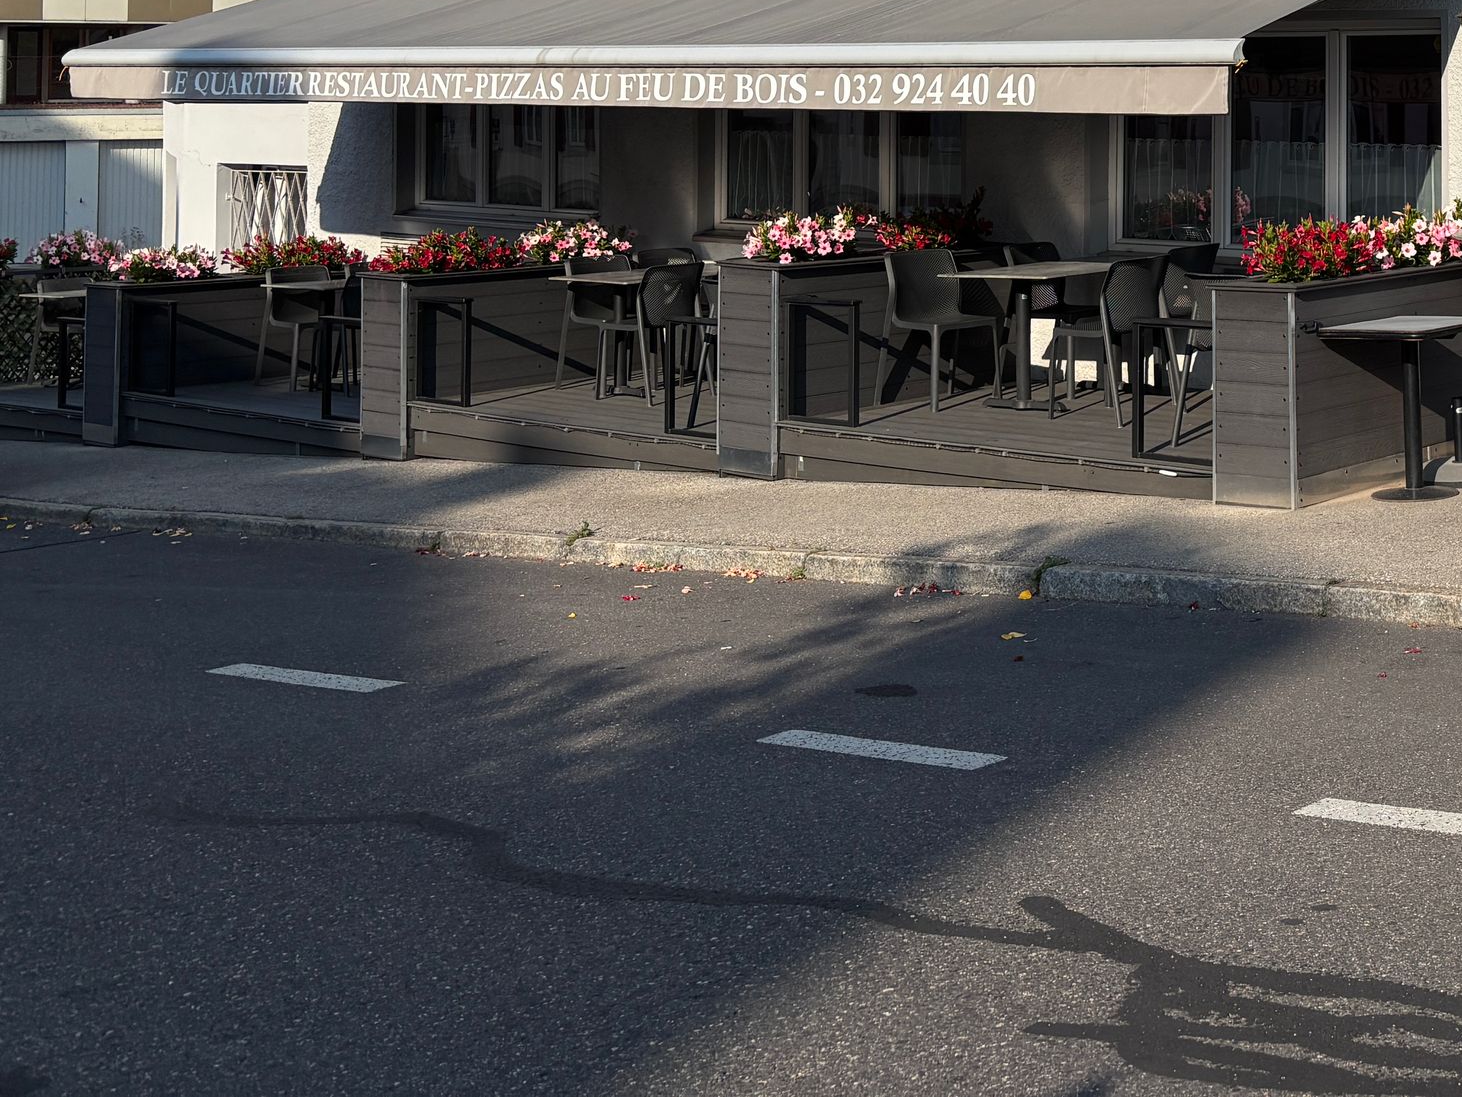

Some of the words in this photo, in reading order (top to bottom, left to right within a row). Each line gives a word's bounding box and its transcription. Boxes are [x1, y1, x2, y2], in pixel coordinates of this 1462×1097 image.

[161, 70, 189, 95] LE
[194, 70, 304, 96] QUARTIER
[571, 73, 612, 101] AU
[616, 72, 676, 102] FEU
[681, 73, 727, 102] DE
[733, 73, 808, 104] BOIS
[834, 73, 883, 104] 032
[892, 73, 944, 105] 924
[951, 73, 990, 105] 40
[996, 73, 1037, 106] 40
